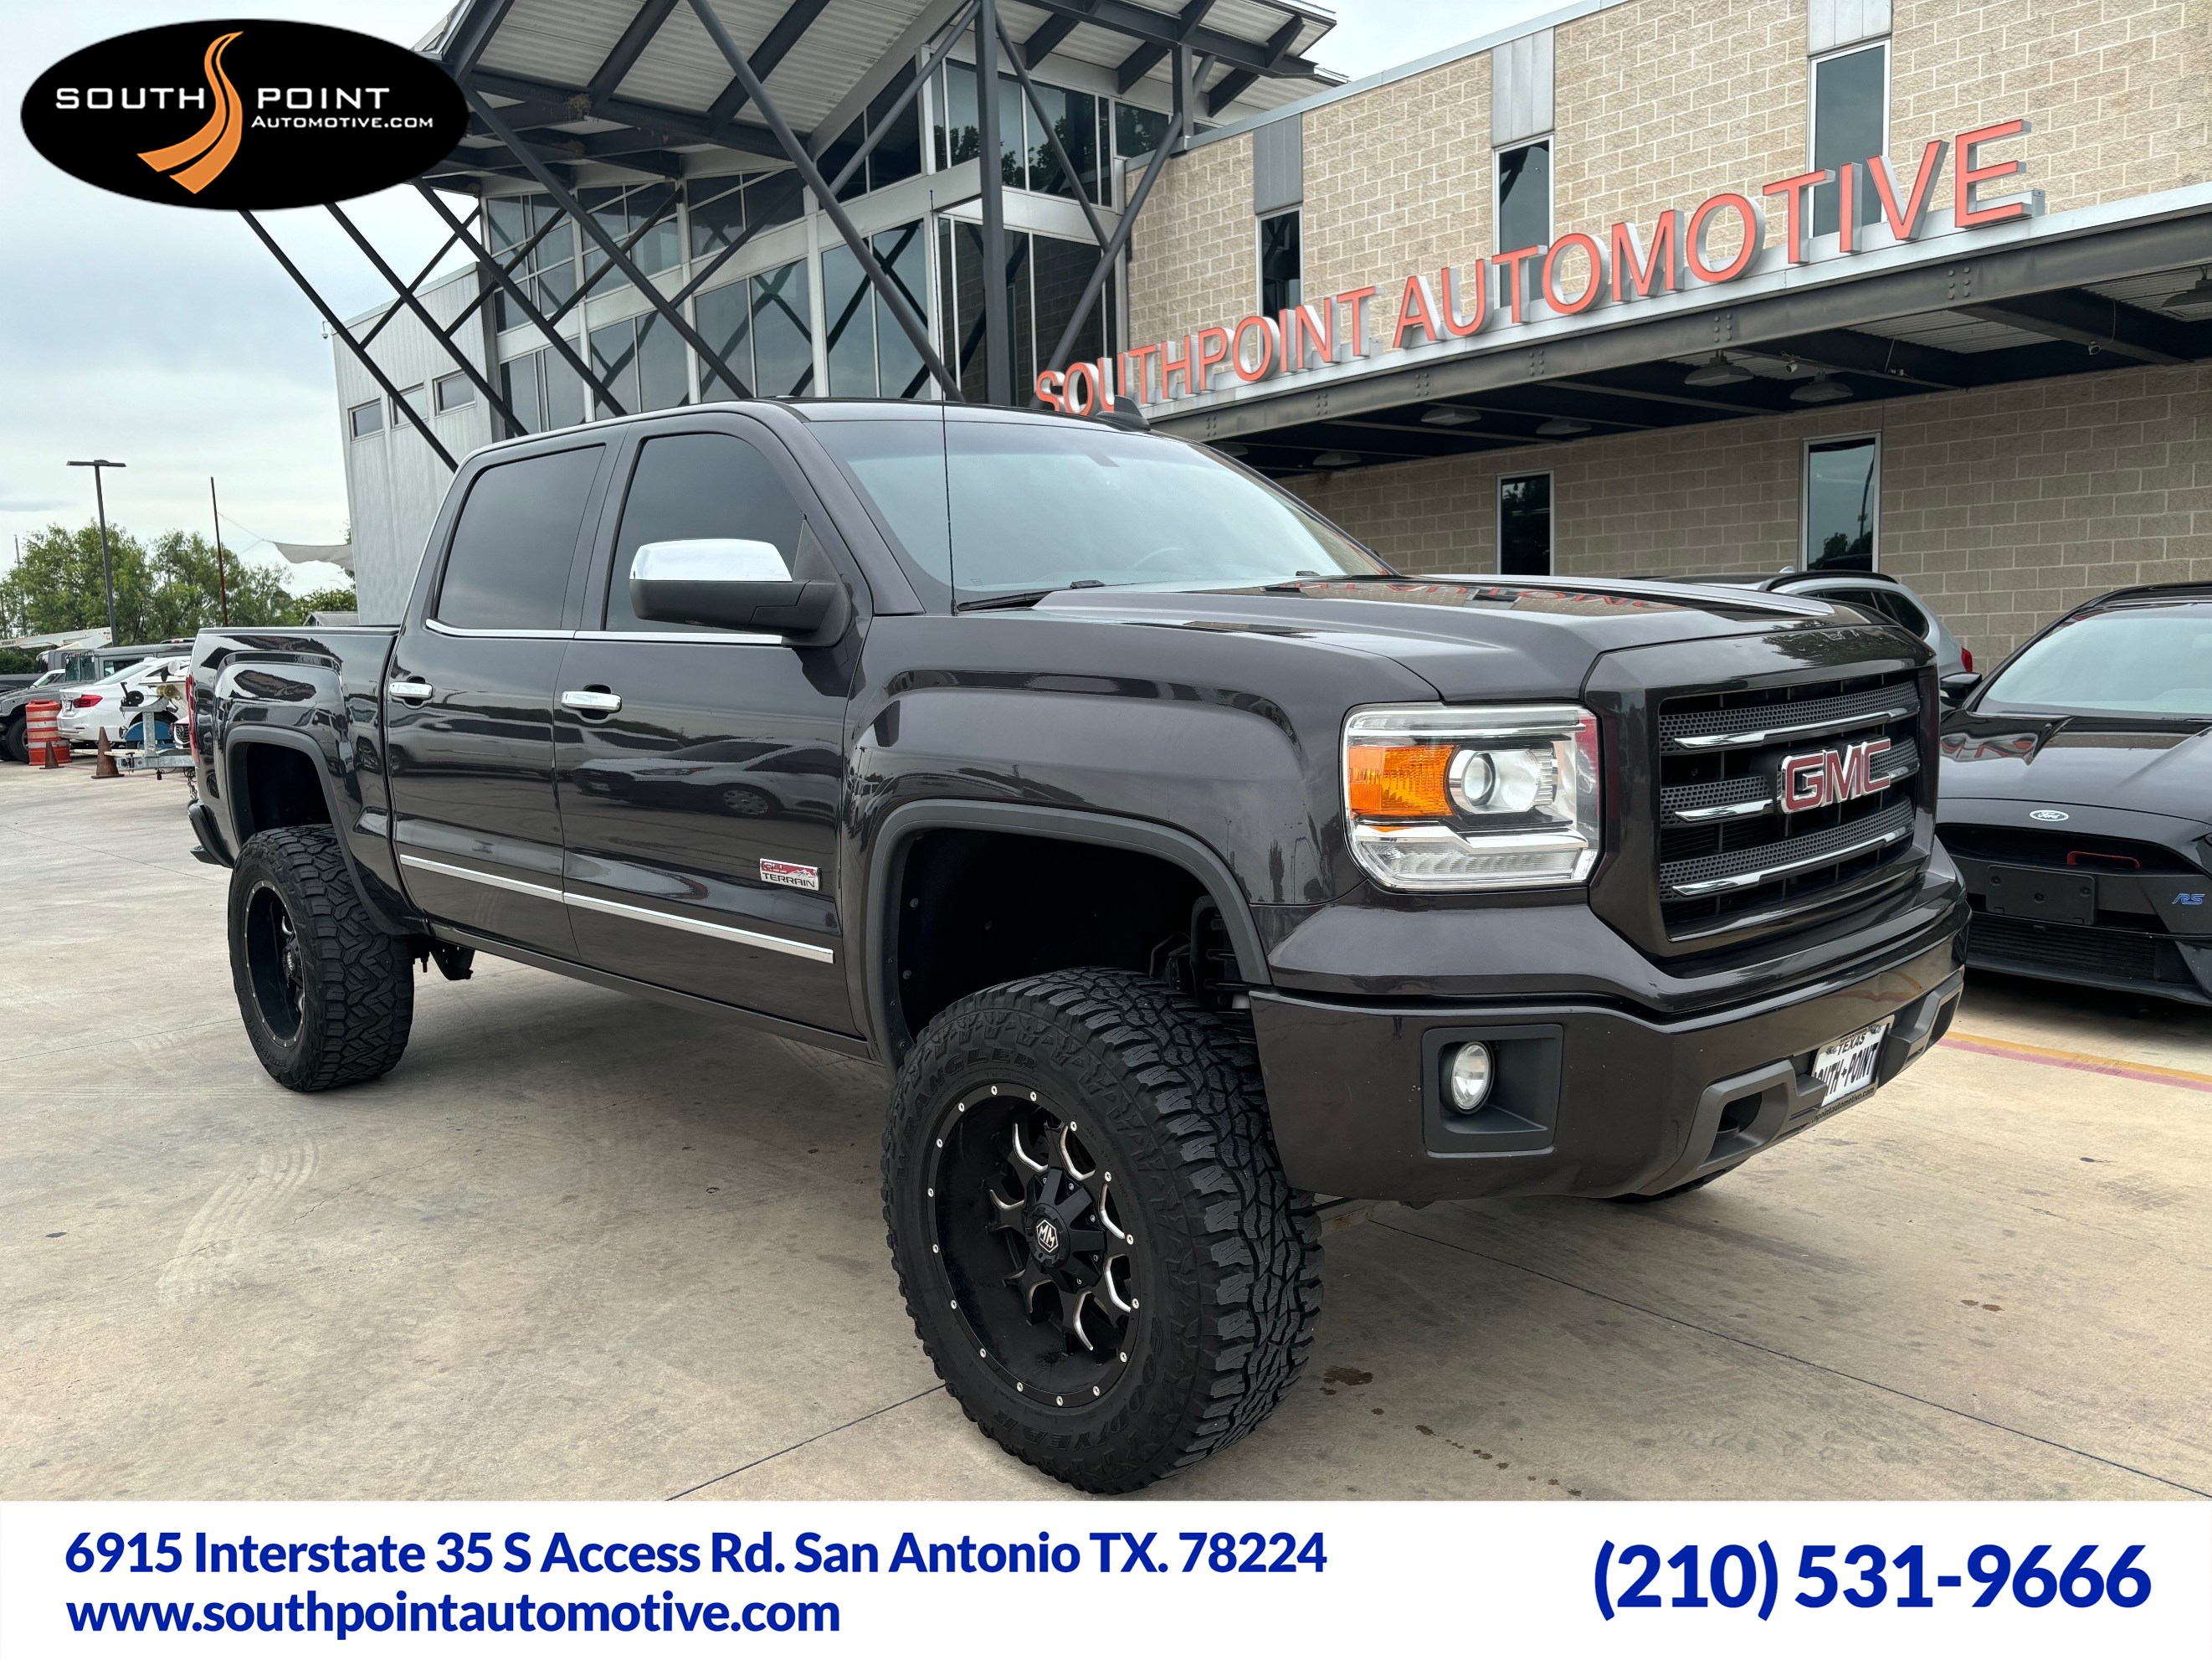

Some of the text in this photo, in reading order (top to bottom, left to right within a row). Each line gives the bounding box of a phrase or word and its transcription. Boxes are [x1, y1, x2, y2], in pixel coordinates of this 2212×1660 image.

[1036, 119, 2032, 416] SOUTHPOINT AUTOMOTIVE
[1782, 737, 1891, 814] GMC
[762, 873, 815, 887] TERRAIN
[2172, 893, 2205, 905] RS
[1838, 1032, 1866, 1056] TEXAS
[1844, 1042, 1879, 1087] POINT
